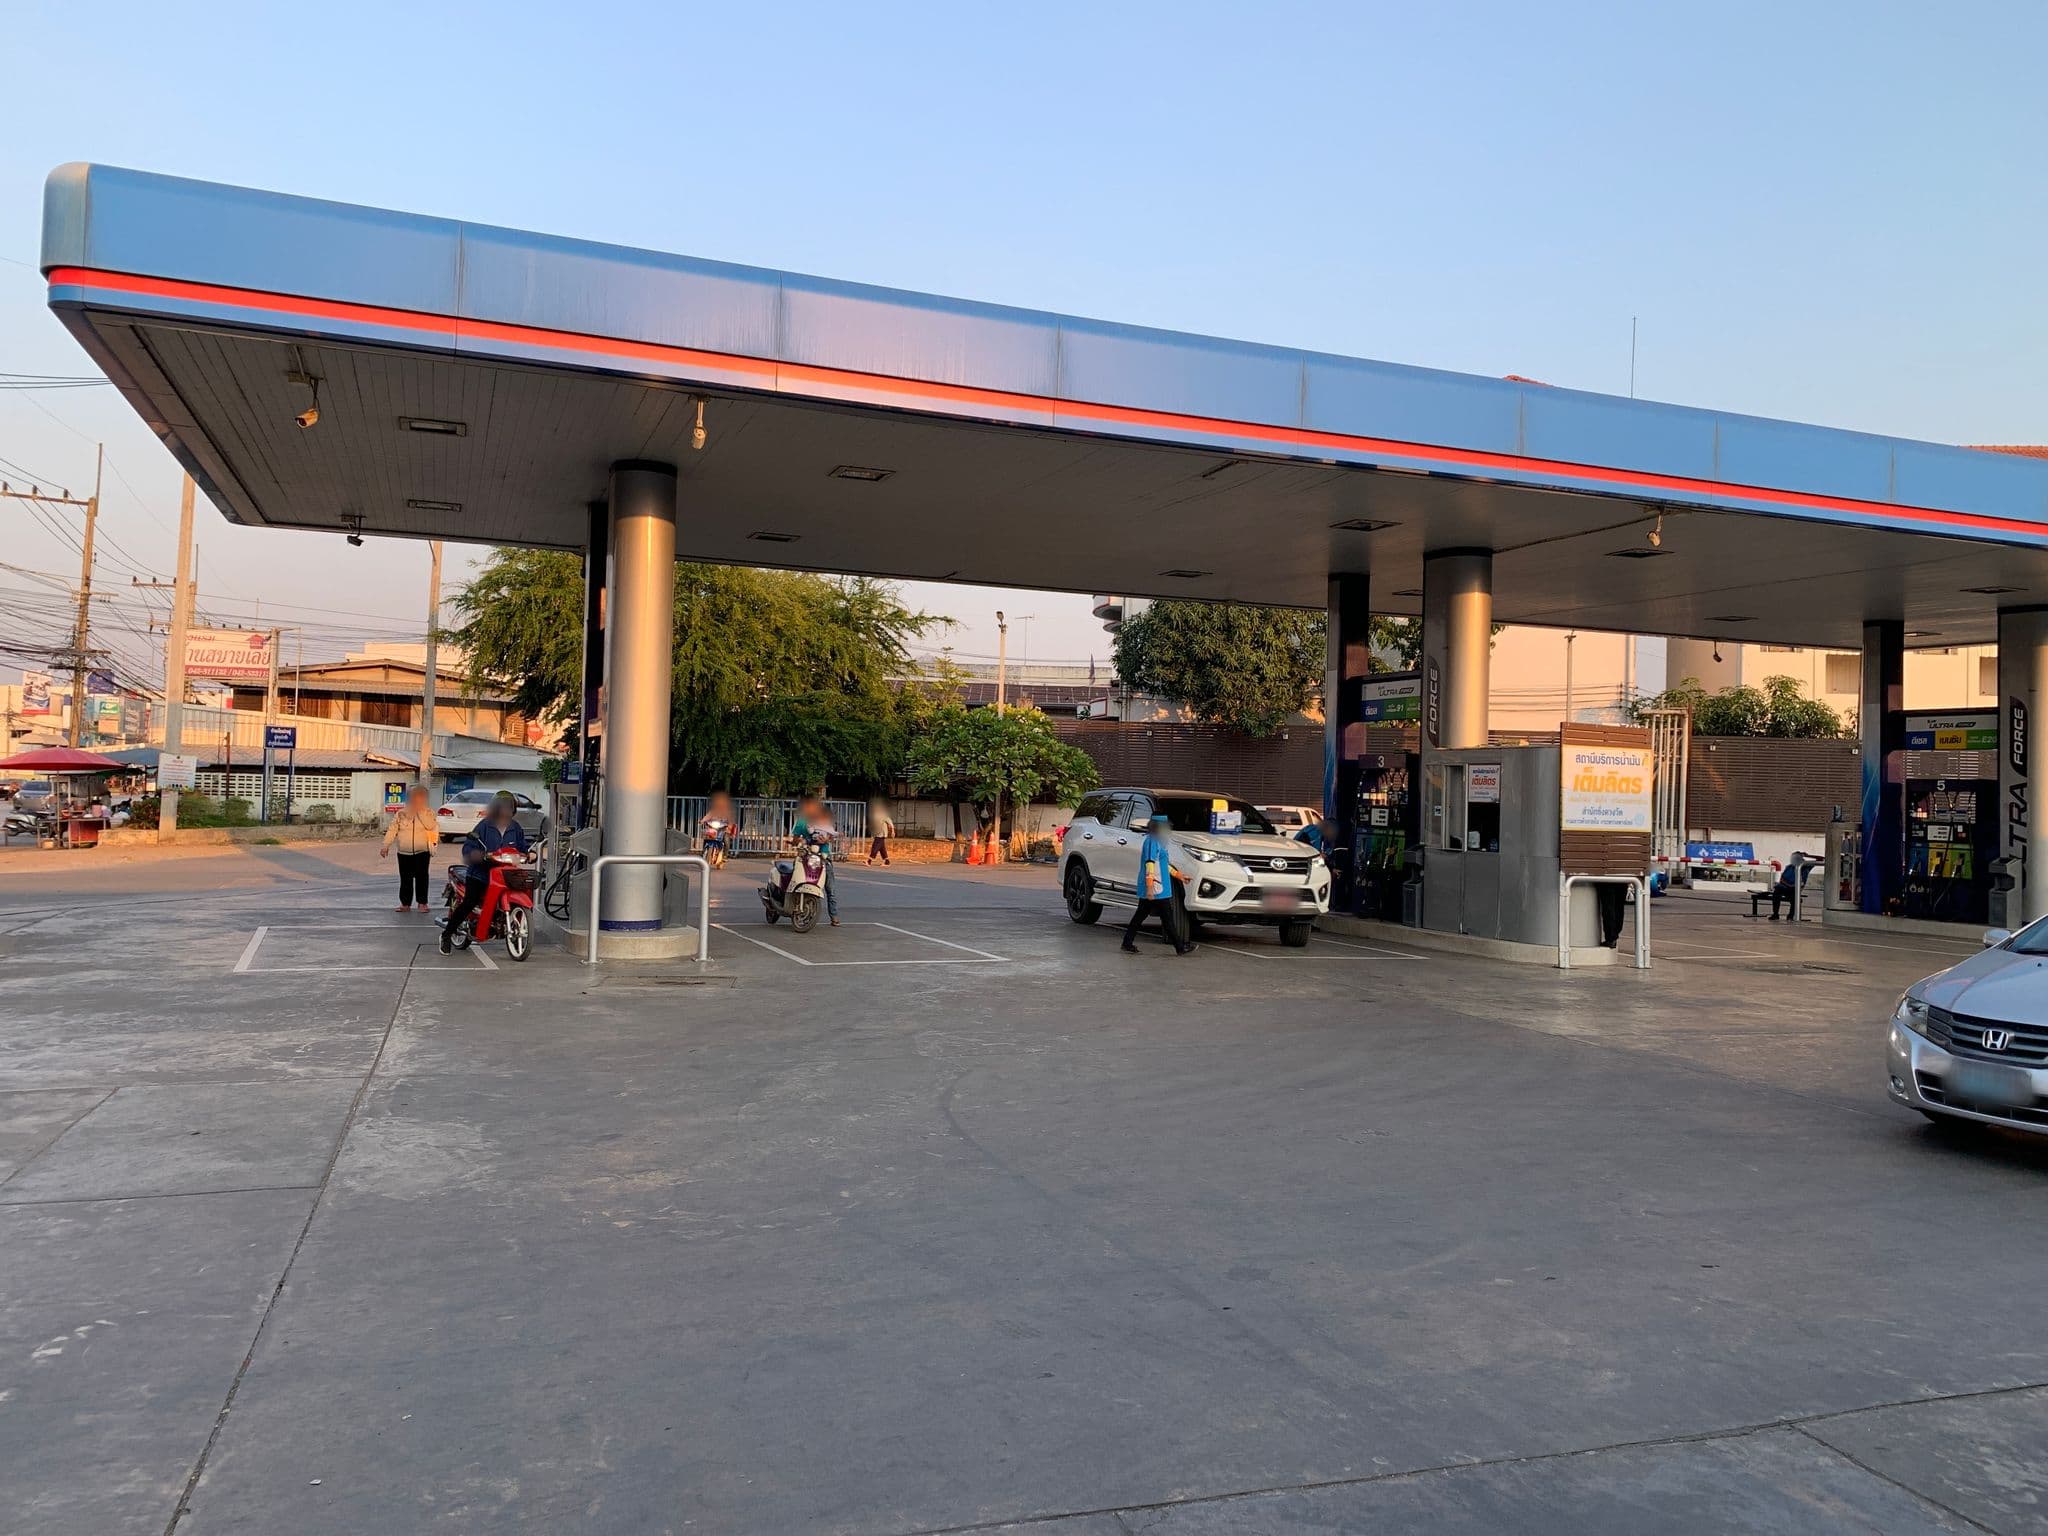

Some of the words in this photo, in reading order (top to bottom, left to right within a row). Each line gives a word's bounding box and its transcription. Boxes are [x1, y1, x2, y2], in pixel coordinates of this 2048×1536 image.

[1429, 668, 1438, 735] FORCE
[2014, 708, 2023, 765] FORCE
[1378, 755, 1384, 768] 3
[1576, 752, 1640, 766] สถานีบริการน้ำมัน
[1573, 767, 1642, 794] เต็มลิตร
[1936, 780, 1945, 791] 5
[2009, 782, 2027, 889] LTRA
